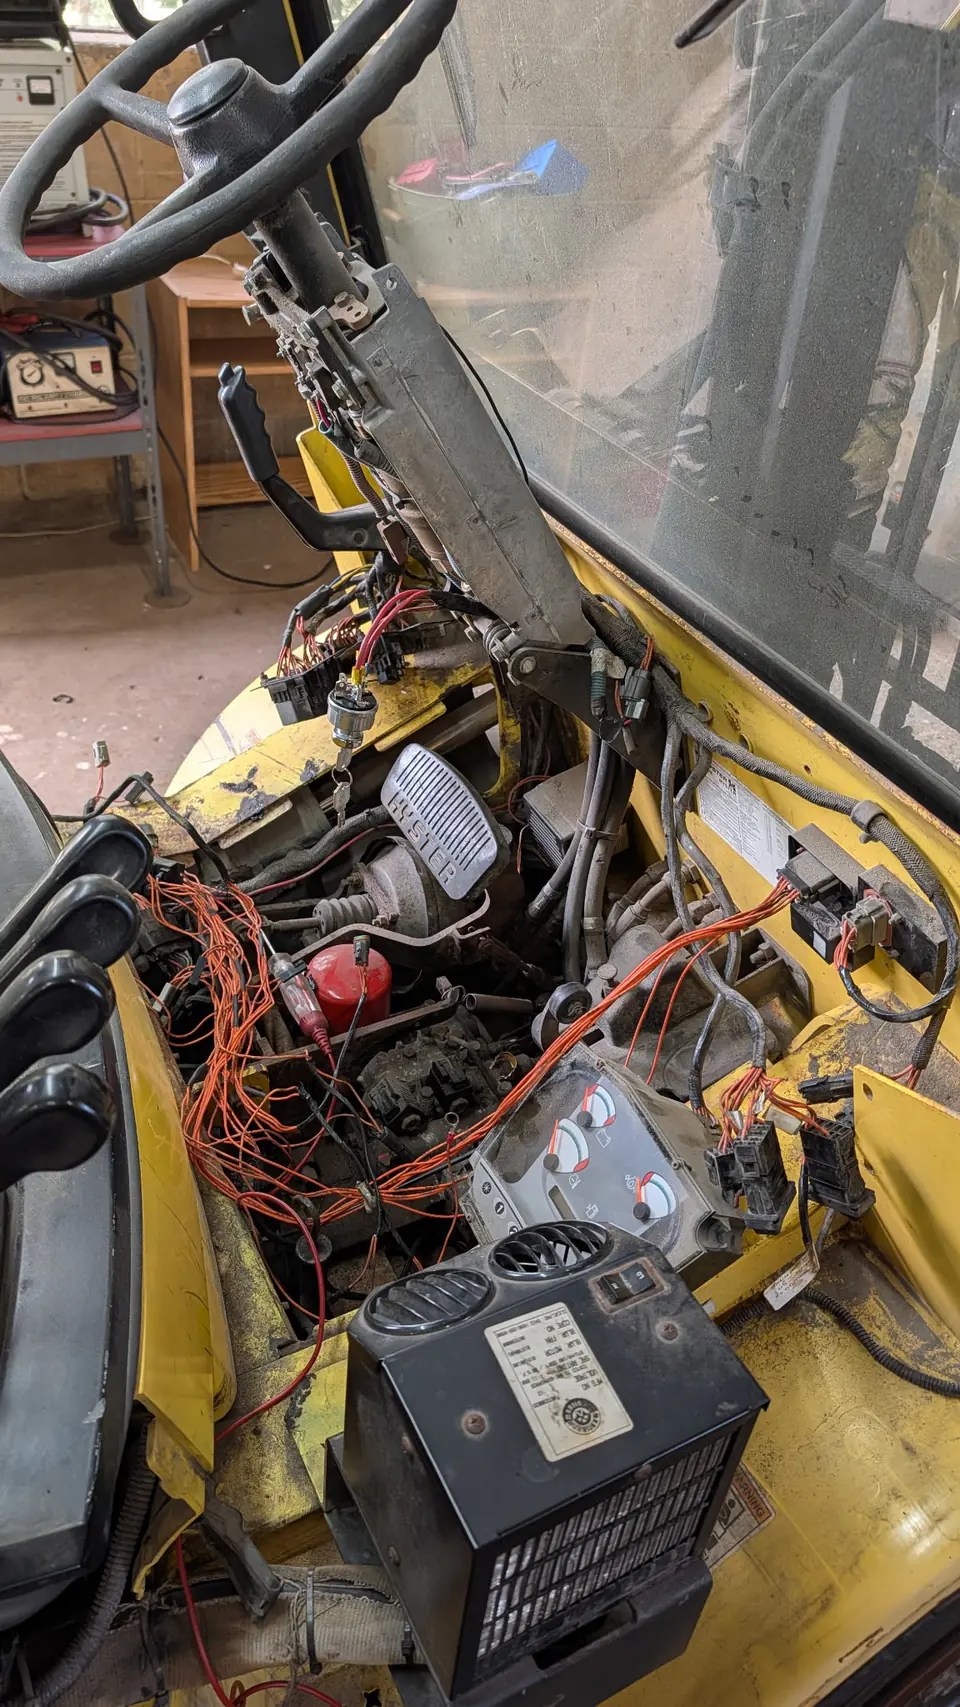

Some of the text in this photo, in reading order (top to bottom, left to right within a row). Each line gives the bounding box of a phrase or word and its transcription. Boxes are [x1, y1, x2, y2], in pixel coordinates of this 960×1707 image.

[388, 791, 457, 884] HYSTER
[544, 1346, 562, 1356] MOTOR
[574, 1368, 599, 1382] VOLTAGE
